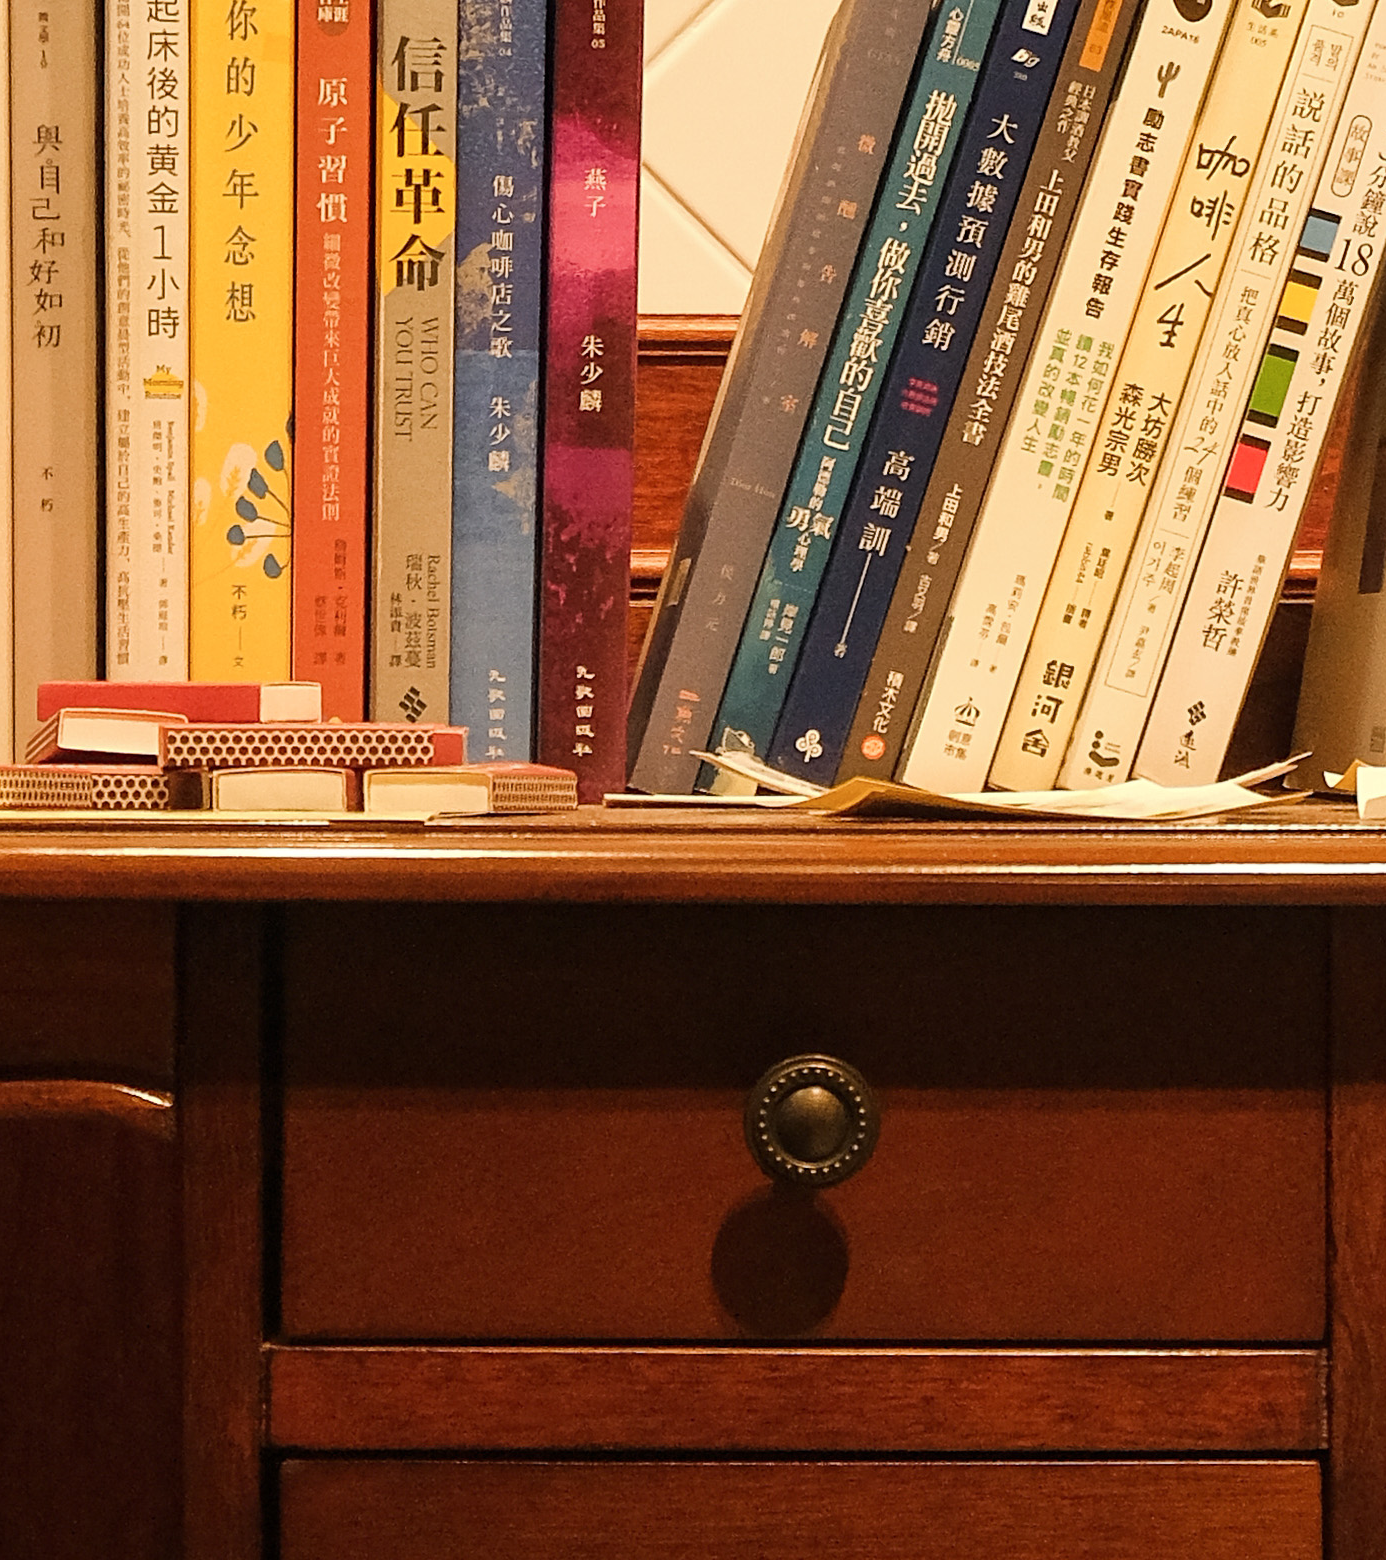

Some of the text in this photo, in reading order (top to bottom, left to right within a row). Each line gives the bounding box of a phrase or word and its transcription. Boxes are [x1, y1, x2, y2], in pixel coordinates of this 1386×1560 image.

[316, 76, 350, 225] 原子習慣
[389, 34, 449, 294] 信任革命
[583, 168, 609, 220] 燕子
[1248, 87, 1329, 268] 說話的品格
[1335, 124, 1368, 187] 故事課
[27, 122, 65, 349] 與自己和好如初
[490, 173, 516, 359] 傷心咖啡店之歌
[821, 88, 959, 452] 拋開過去，做你喜歡的自己
[921, 113, 1019, 352] 大數據預測行銷
[1084, 106, 1167, 321] 勵志書實踐生存報告
[1153, 134, 1252, 349] 咖啡人生
[961, 168, 1067, 447] 上田和男的雞尾酒技法全書
[319, 231, 342, 523] 細微改變帶來巨大成就的實證法則
[393, 316, 415, 442] YOU TRUST
[419, 316, 441, 431] WHO CAN
[578, 334, 605, 414] 朱少麟
[1019, 327, 1074, 455] 並真的改變人生
[1050, 339, 1117, 504] 我如何花一年的時間
[1096, 382, 1146, 478] 森光宗男
[1170, 285, 1260, 524] 把真心放入話中的24個練習
[40, 465, 54, 514] 不朽
[487, 395, 512, 473] 朱少麟
[1125, 391, 1174, 488] 大坊勝次
[784, 504, 834, 541] 勇氣
[858, 450, 916, 558] 高端訓
[230, 584, 248, 622] 不朽
[426, 553, 441, 603] Rachel
[1201, 568, 1246, 654] 許榮哲
[871, 669, 905, 735] 積木文化
[1020, 658, 1076, 759] 銀河舍
